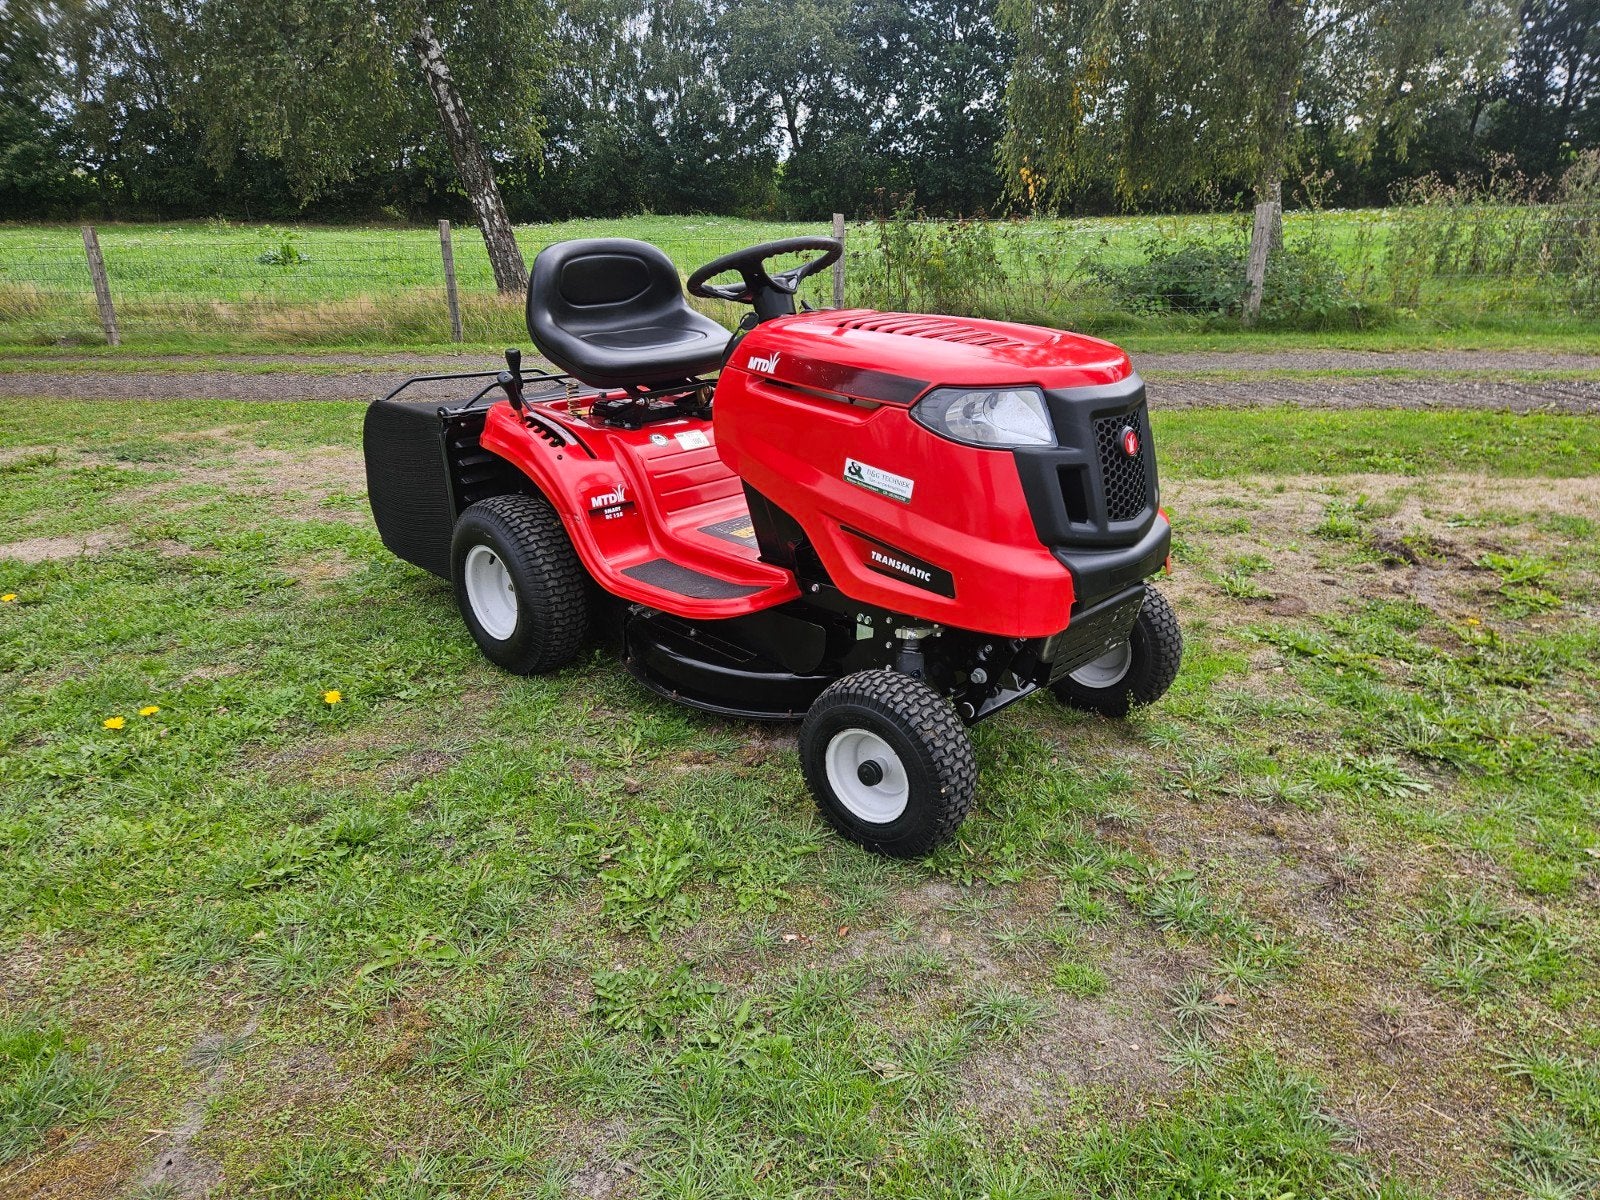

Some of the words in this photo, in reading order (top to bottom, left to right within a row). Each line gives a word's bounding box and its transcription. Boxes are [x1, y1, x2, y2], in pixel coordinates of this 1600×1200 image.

[748, 356, 770, 372] MTD
[591, 493, 617, 508] MTD
[871, 550, 931, 582] TRANSMATIC
